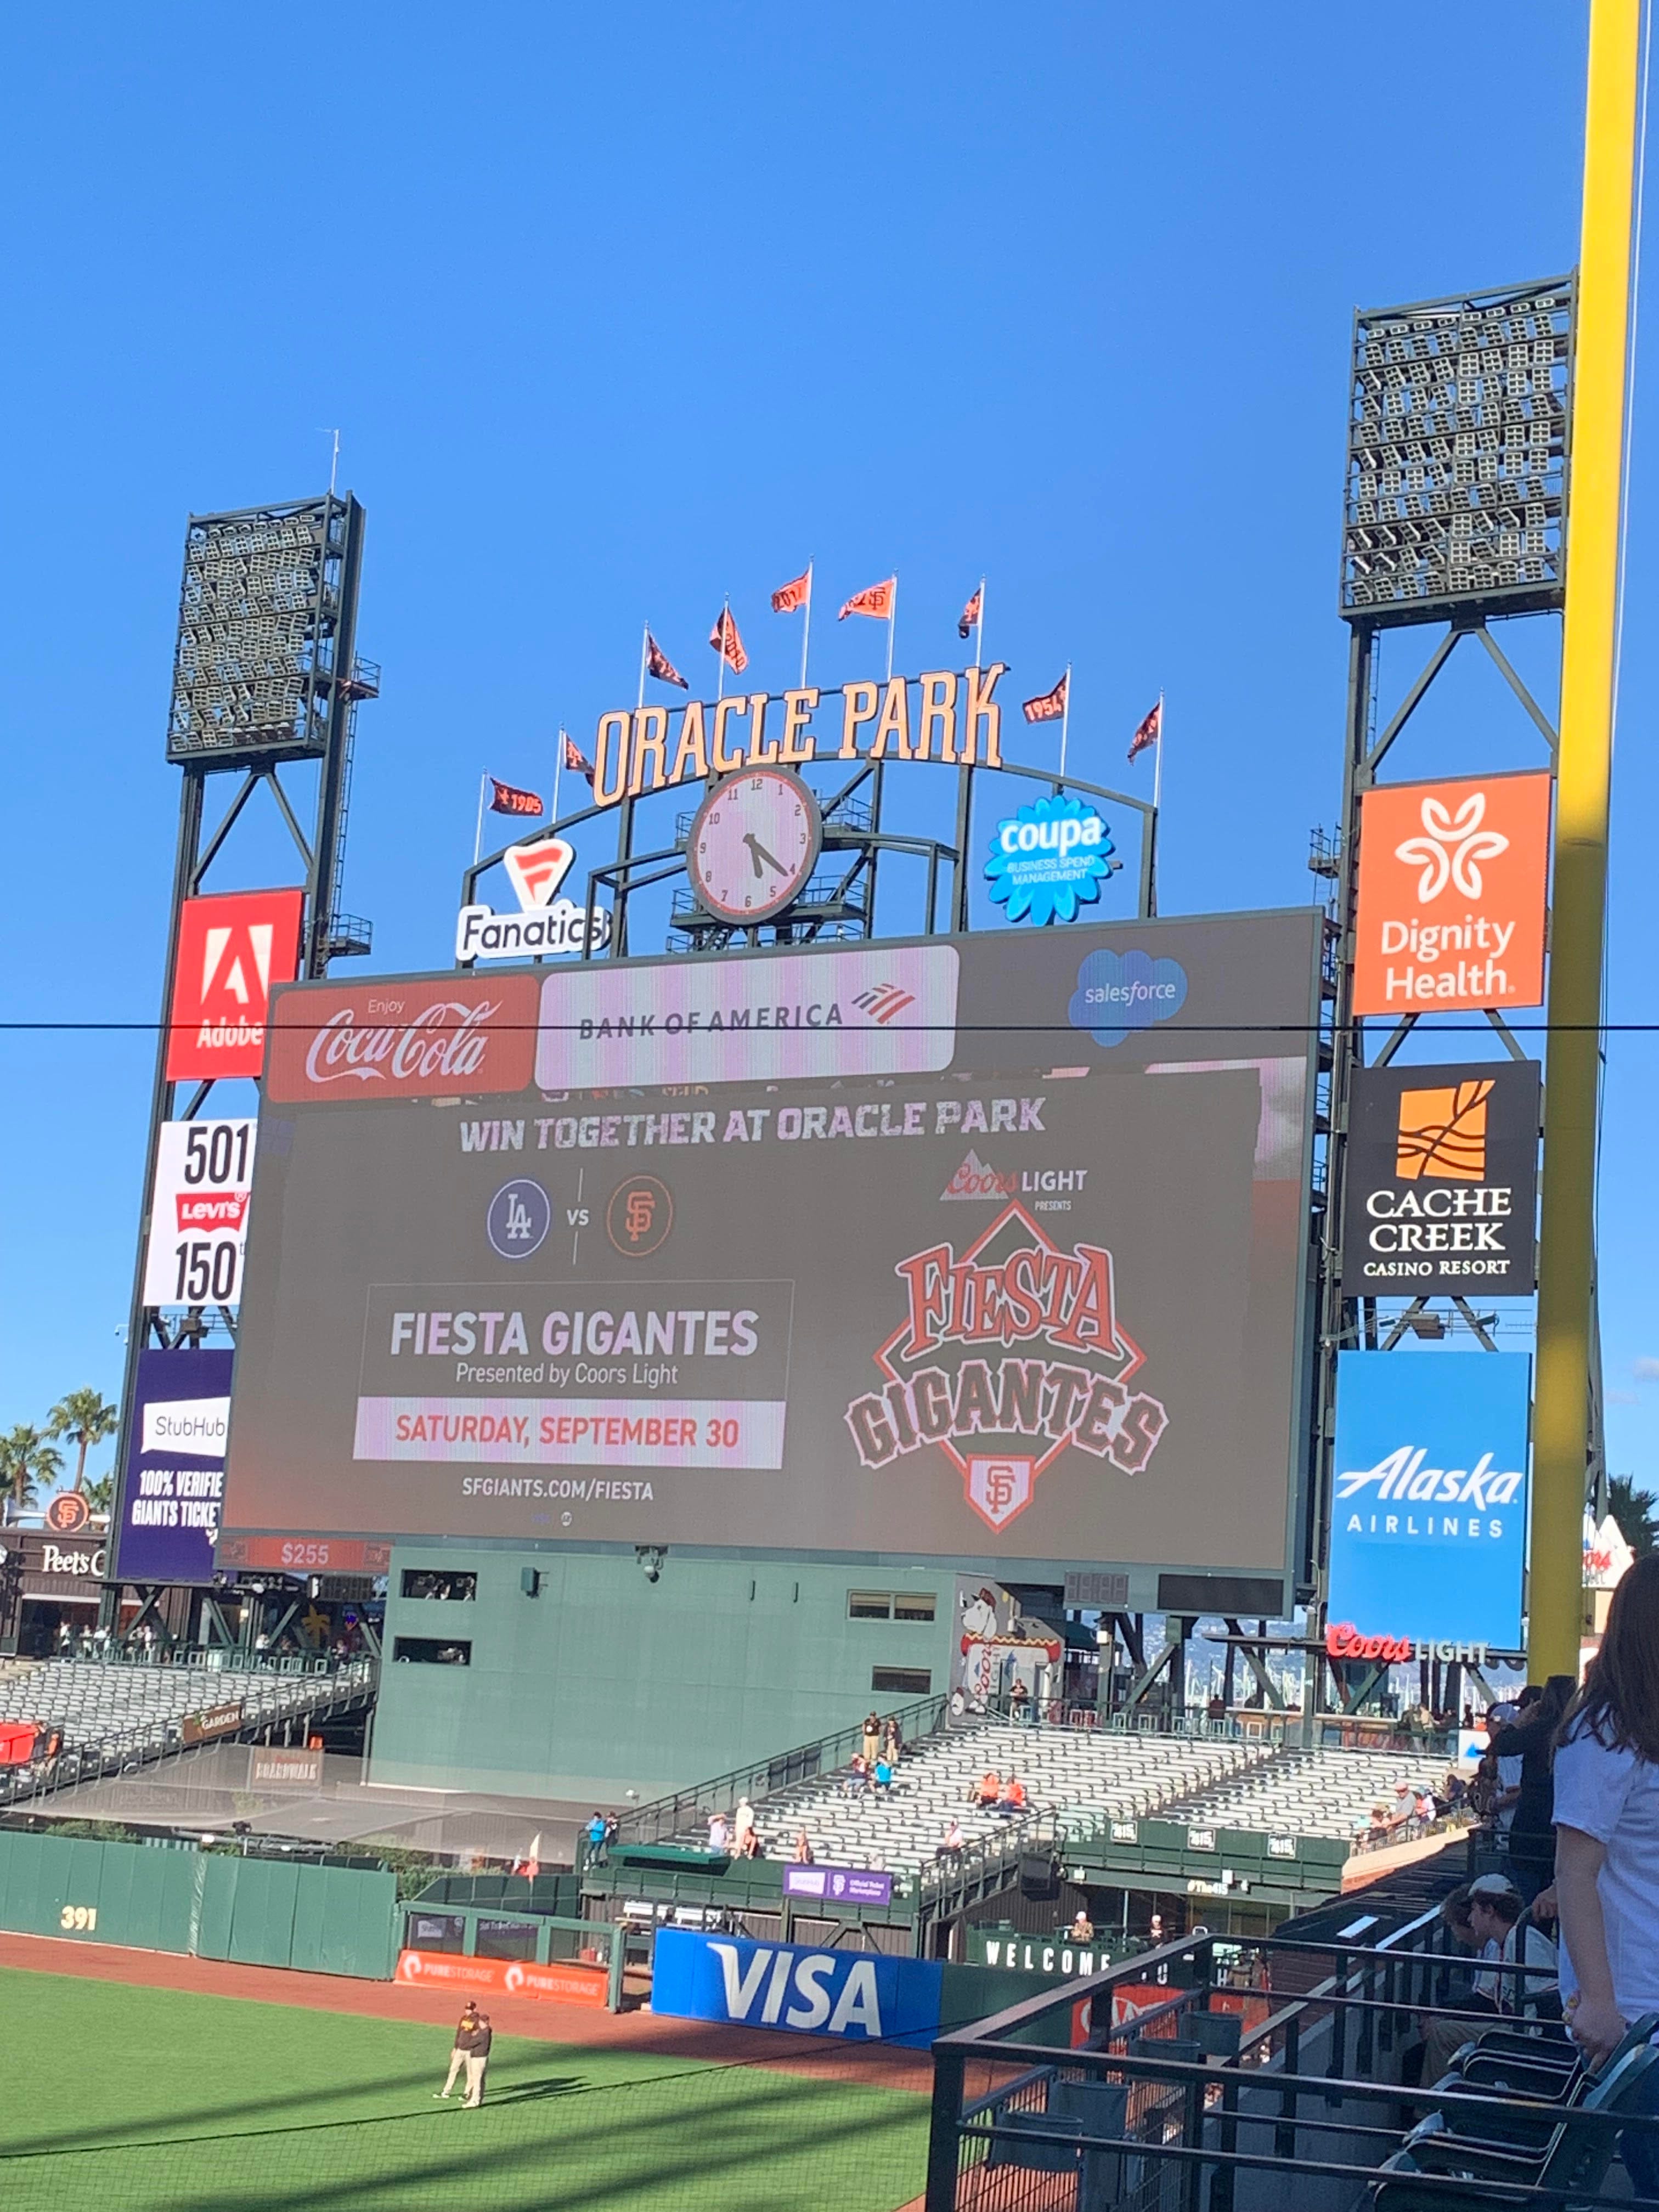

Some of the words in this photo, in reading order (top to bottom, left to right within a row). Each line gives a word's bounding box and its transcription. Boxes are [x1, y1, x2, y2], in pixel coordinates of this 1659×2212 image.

[1025, 696, 1062, 721] 1954
[592, 686, 820, 808] ORACLE
[838, 662, 1005, 768] PARK
[727, 788, 738, 801] 11
[751, 777, 763, 791] 12
[777, 783, 783, 795] 1
[511, 793, 541, 814] 1905
[794, 804, 802, 816] 2
[708, 812, 720, 825] 10
[699, 842, 707, 853] 9
[799, 832, 806, 845] 3
[1000, 815, 1102, 859] coupa
[705, 870, 712, 882] 8
[789, 863, 797, 875] 4
[1007, 858, 1057, 874] BUSINESS
[1059, 856, 1096, 871] SPEND
[1012, 868, 1087, 885] MANAGEMENT
[721, 889, 729, 902] 7
[744, 895, 752, 908] 6
[769, 885, 777, 898] 5
[463, 909, 603, 950] Fanatics
[1381, 914, 1516, 963] Dignity
[1085, 980, 1177, 1006] salesforce
[1386, 959, 1507, 1001] Health
[368, 998, 405, 1015] Enjoy
[196, 1015, 263, 1048] Adobe
[579, 1015, 654, 1040] BANK
[665, 1012, 699, 1035] OF
[710, 1003, 843, 1032] AMERICA
[306, 1000, 503, 1083] Coca-Cola
[460, 1119, 524, 1152] WIN
[534, 1110, 716, 1150] TOGETHER
[723, 1109, 770, 1143] AT
[777, 1101, 927, 1141] ORACLE
[935, 1097, 1046, 1135] PARK
[184, 1124, 249, 1184] 501
[947, 1161, 1018, 1194] Coors
[1022, 1170, 1088, 1192] LIGHT
[505, 1193, 533, 1240] LA
[1035, 1200, 1071, 1211] PRESENTS
[1366, 1188, 1512, 1219] CACHE
[1369, 1222, 1505, 1252] CREEK
[1364, 1261, 1432, 1277] CASINO
[1440, 1260, 1511, 1275] RESORT
[895, 1242, 1124, 1361] FIESTA
[391, 1312, 529, 1356] FIESTA
[543, 1308, 759, 1357] GIGANTES
[456, 1362, 544, 1384] Presented
[548, 1363, 571, 1388] by
[575, 1363, 627, 1384] Coors
[633, 1363, 679, 1389] Light
[155, 1415, 225, 1437] StubHub
[843, 1357, 1170, 1476] GIGANTES
[396, 1415, 530, 1448] SATURDAY,
[540, 1415, 696, 1447] SEPTEMBER
[706, 1419, 739, 1447] 30
[140, 1470, 173, 1497] 100%
[177, 1471, 224, 1498] VERIFIE
[462, 1477, 653, 1502] SFGIANTS.COM/FIESTA
[1336, 1445, 1523, 1512] Alaska
[132, 1499, 178, 1527] GIANTS
[1347, 1514, 1503, 1539] AIRLINES
[42, 1544, 90, 1575] Peet's
[281, 1542, 329, 1564] $255
[1325, 1622, 1413, 1663] Coors
[1414, 1637, 1491, 1664] LIGHT
[201, 1710, 239, 1730] GARDEN
[60, 1905, 97, 1931] 391
[986, 1940, 1110, 1976] WELCOME
[707, 1941, 882, 2037] VISA
